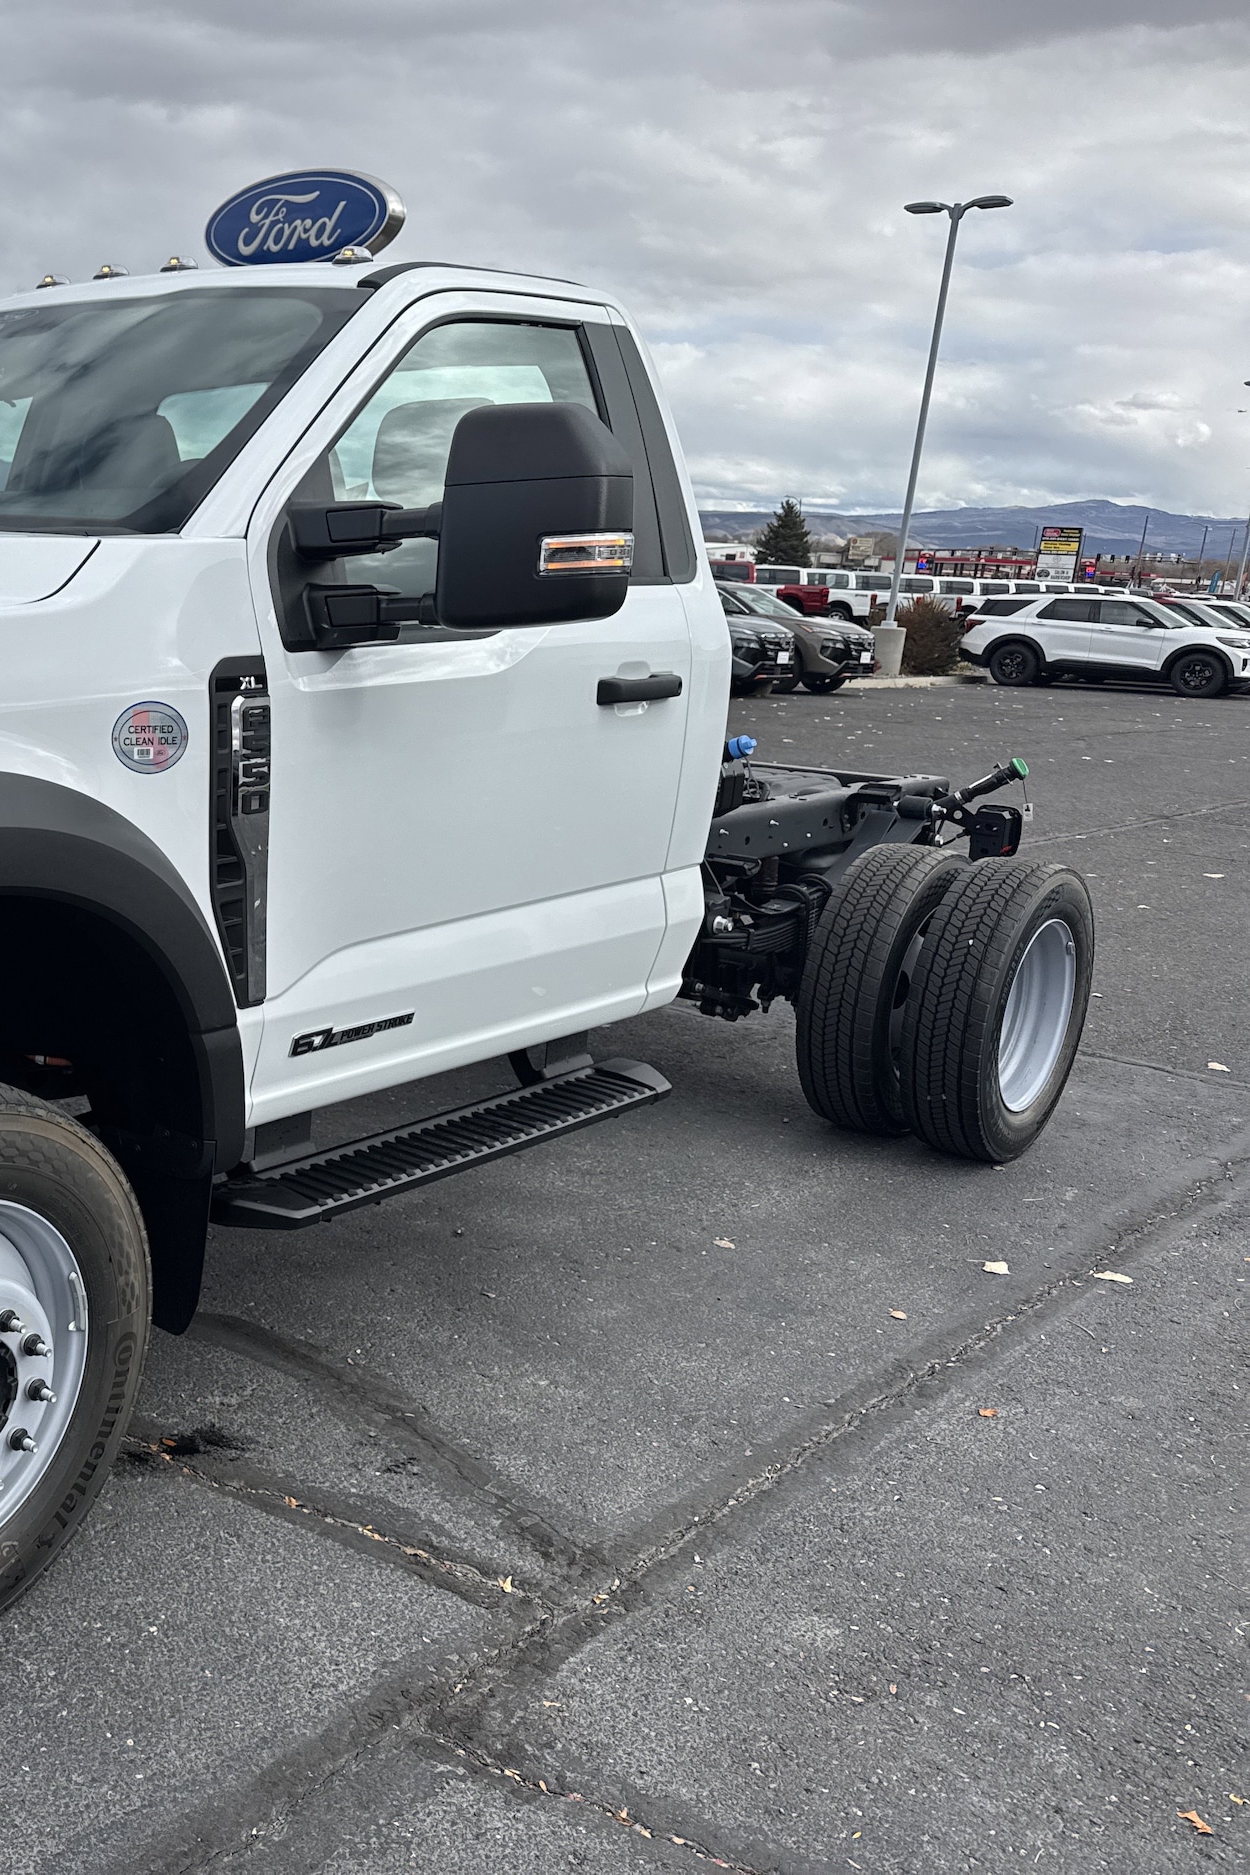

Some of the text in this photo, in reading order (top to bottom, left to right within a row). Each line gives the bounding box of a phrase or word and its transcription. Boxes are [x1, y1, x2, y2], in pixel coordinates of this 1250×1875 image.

[237, 190, 347, 257] Ford
[601, 549, 630, 557] FORD
[240, 676, 263, 690] XL
[127, 724, 174, 734] CERTIFIED
[123, 736, 178, 747] CLEAN IDLE
[340, 1023, 376, 1040] POWER
[374, 1012, 416, 1032] STROKE
[52, 1331, 138, 1529] Continental
